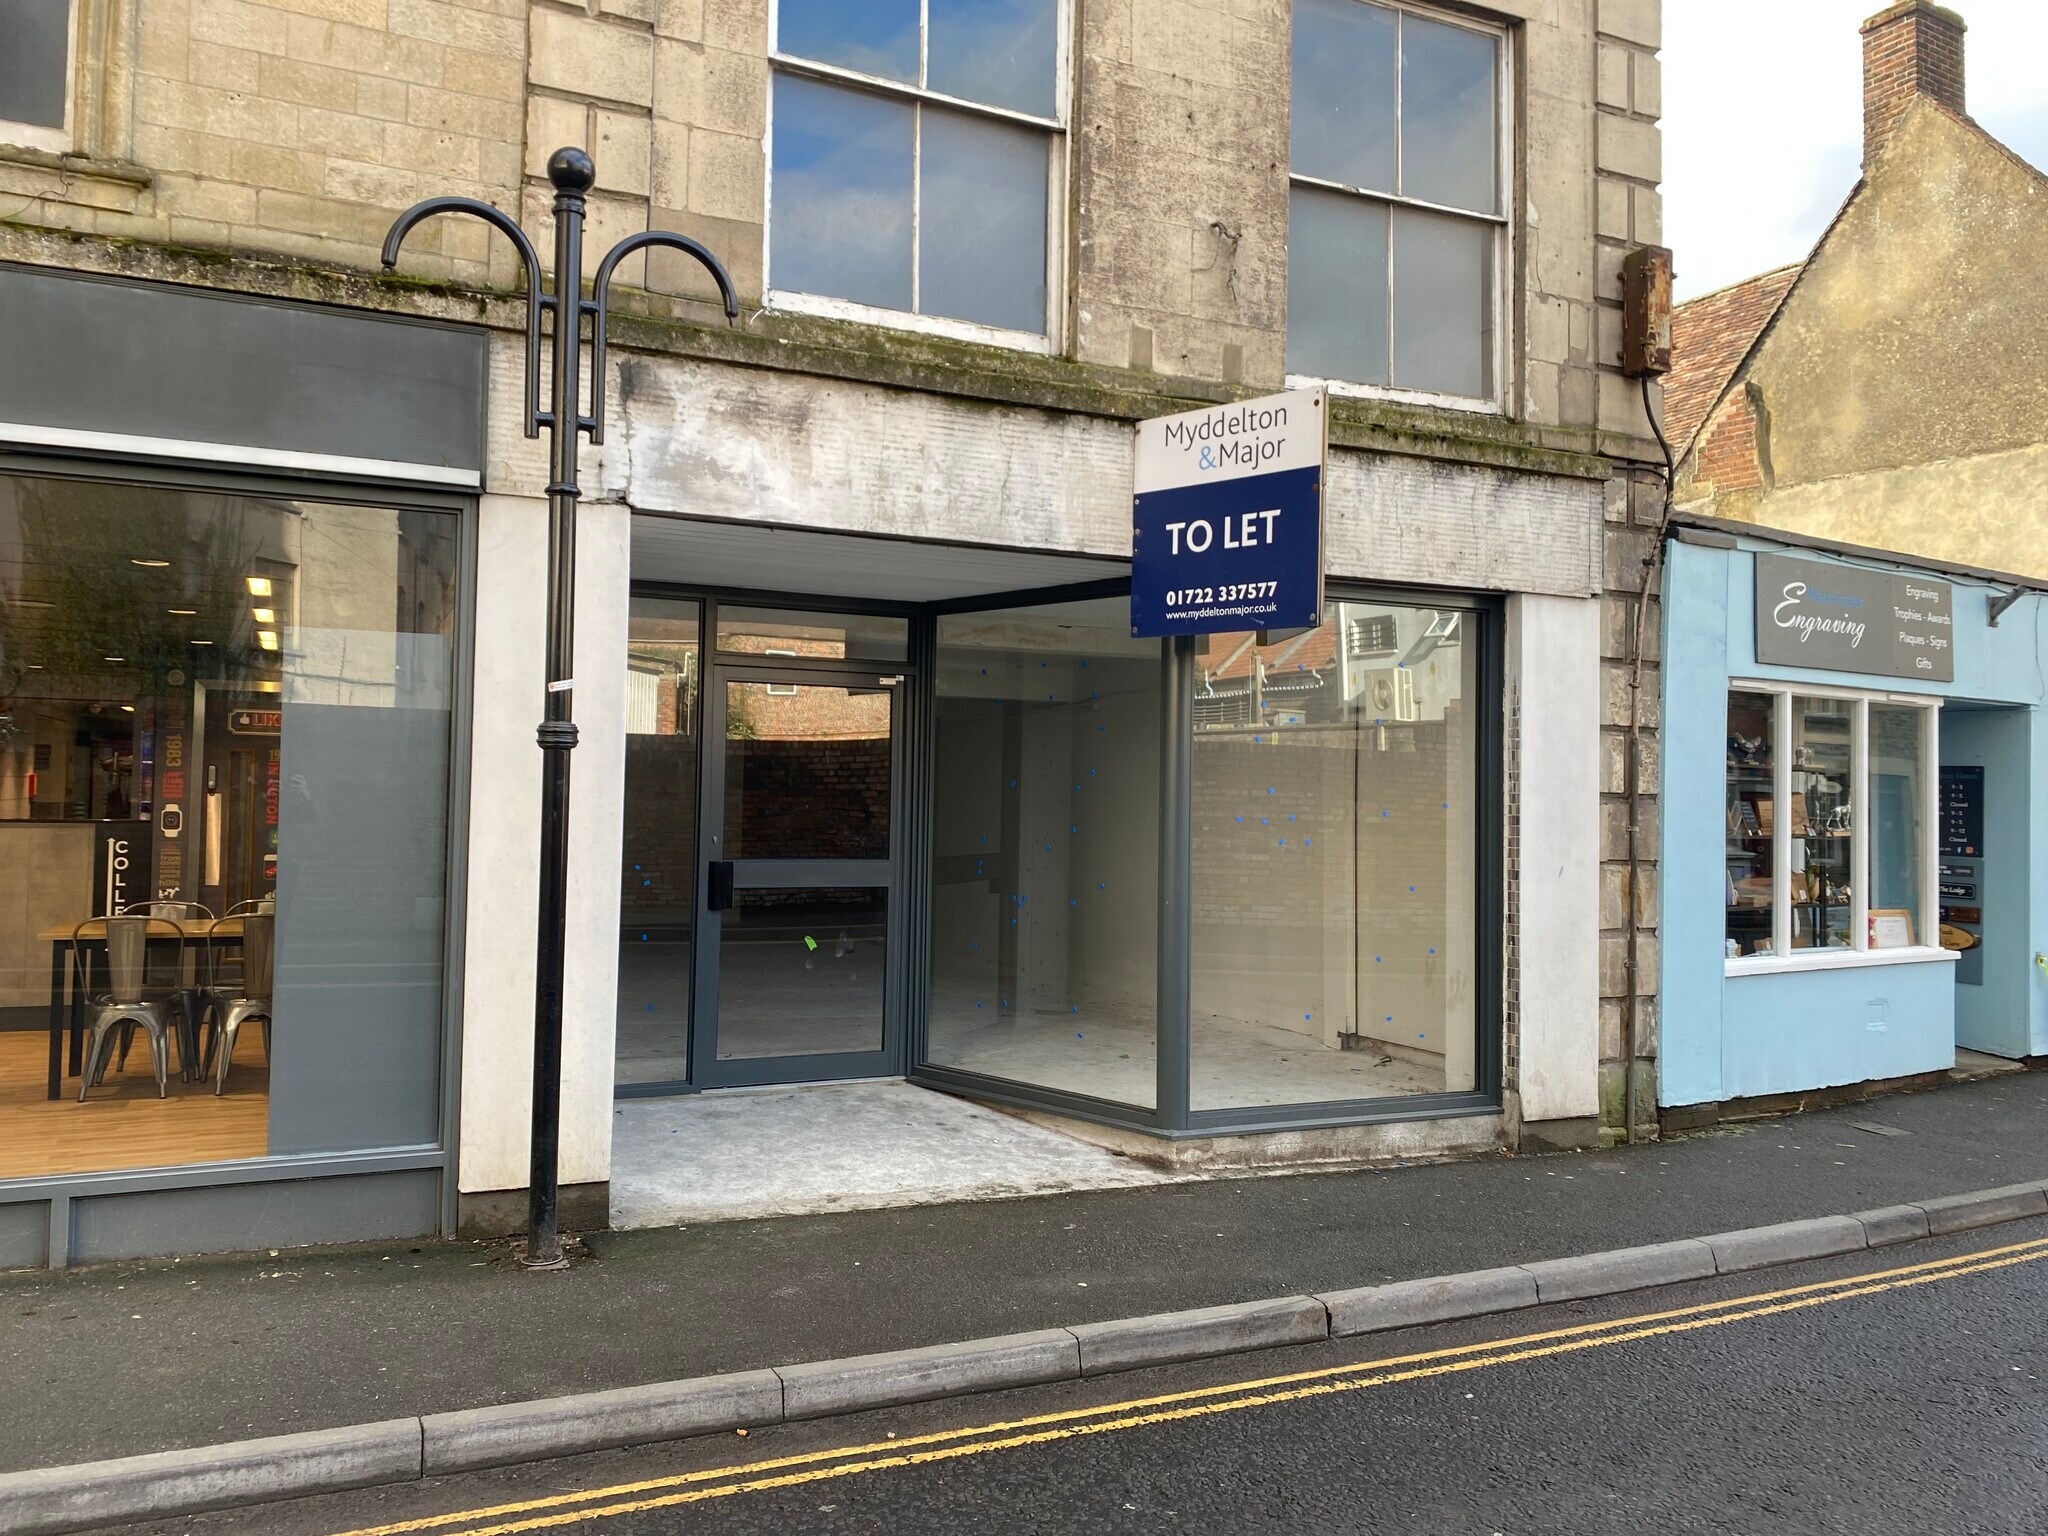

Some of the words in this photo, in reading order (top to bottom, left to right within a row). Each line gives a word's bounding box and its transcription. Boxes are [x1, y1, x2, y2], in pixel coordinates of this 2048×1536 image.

[1165, 407, 1287, 451] Myddelton
[1166, 519, 1213, 555] TO
[1224, 509, 1281, 549] LET
[1166, 588, 1214, 606] 01722
[1218, 581, 1278, 602] 337577
[1906, 584, 1939, 603] Engraving
[1166, 602, 1277, 620] www.myddeltonmajor.co.uk
[1774, 582, 1866, 648] Engraving
[1893, 606, 1922, 623] Trophies
[1927, 612, 1951, 625] Awards
[1899, 631, 1925, 647] Plaques
[1930, 635, 1948, 650] Signs
[1916, 657, 1933, 669] Gifts
[252, 713, 281, 726] LIK
[165, 734, 183, 767] 1983
